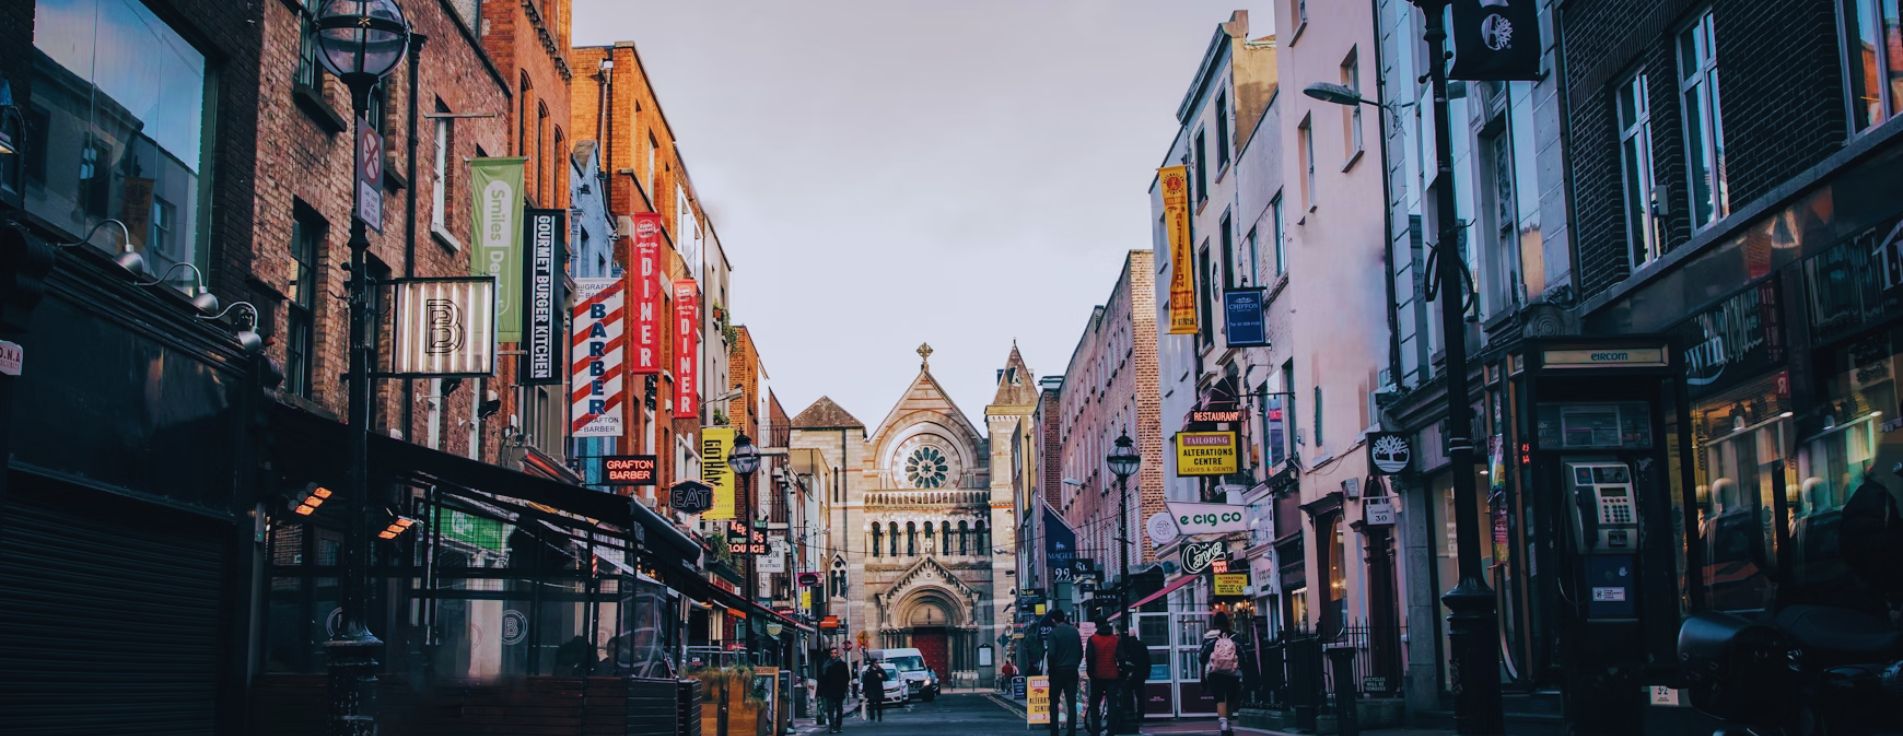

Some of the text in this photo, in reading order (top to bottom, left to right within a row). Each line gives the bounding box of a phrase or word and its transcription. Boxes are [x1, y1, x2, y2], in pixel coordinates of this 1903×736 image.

[491, 189, 505, 241] Smiles
[534, 215, 551, 378] GOURMET BURGER KITCHEN
[641, 257, 652, 367] DINER
[425, 299, 465, 355] B
[589, 303, 606, 415] BARBER
[1590, 352, 1628, 361] eircom
[680, 318, 691, 413] DINER
[1194, 411, 1239, 422] RESTAURANT
[583, 425, 616, 433] BARBER
[1185, 436, 1228, 445] TAILORING
[1183, 448, 1233, 456] ALTERATIONS
[606, 460, 654, 469] GRAFTON
[1194, 458, 1222, 466] CENTRE
[609, 471, 651, 480] BARBER
[672, 487, 710, 508] EAT
[1180, 512, 1242, 527] e cig co
[1055, 568, 1071, 581] 22
